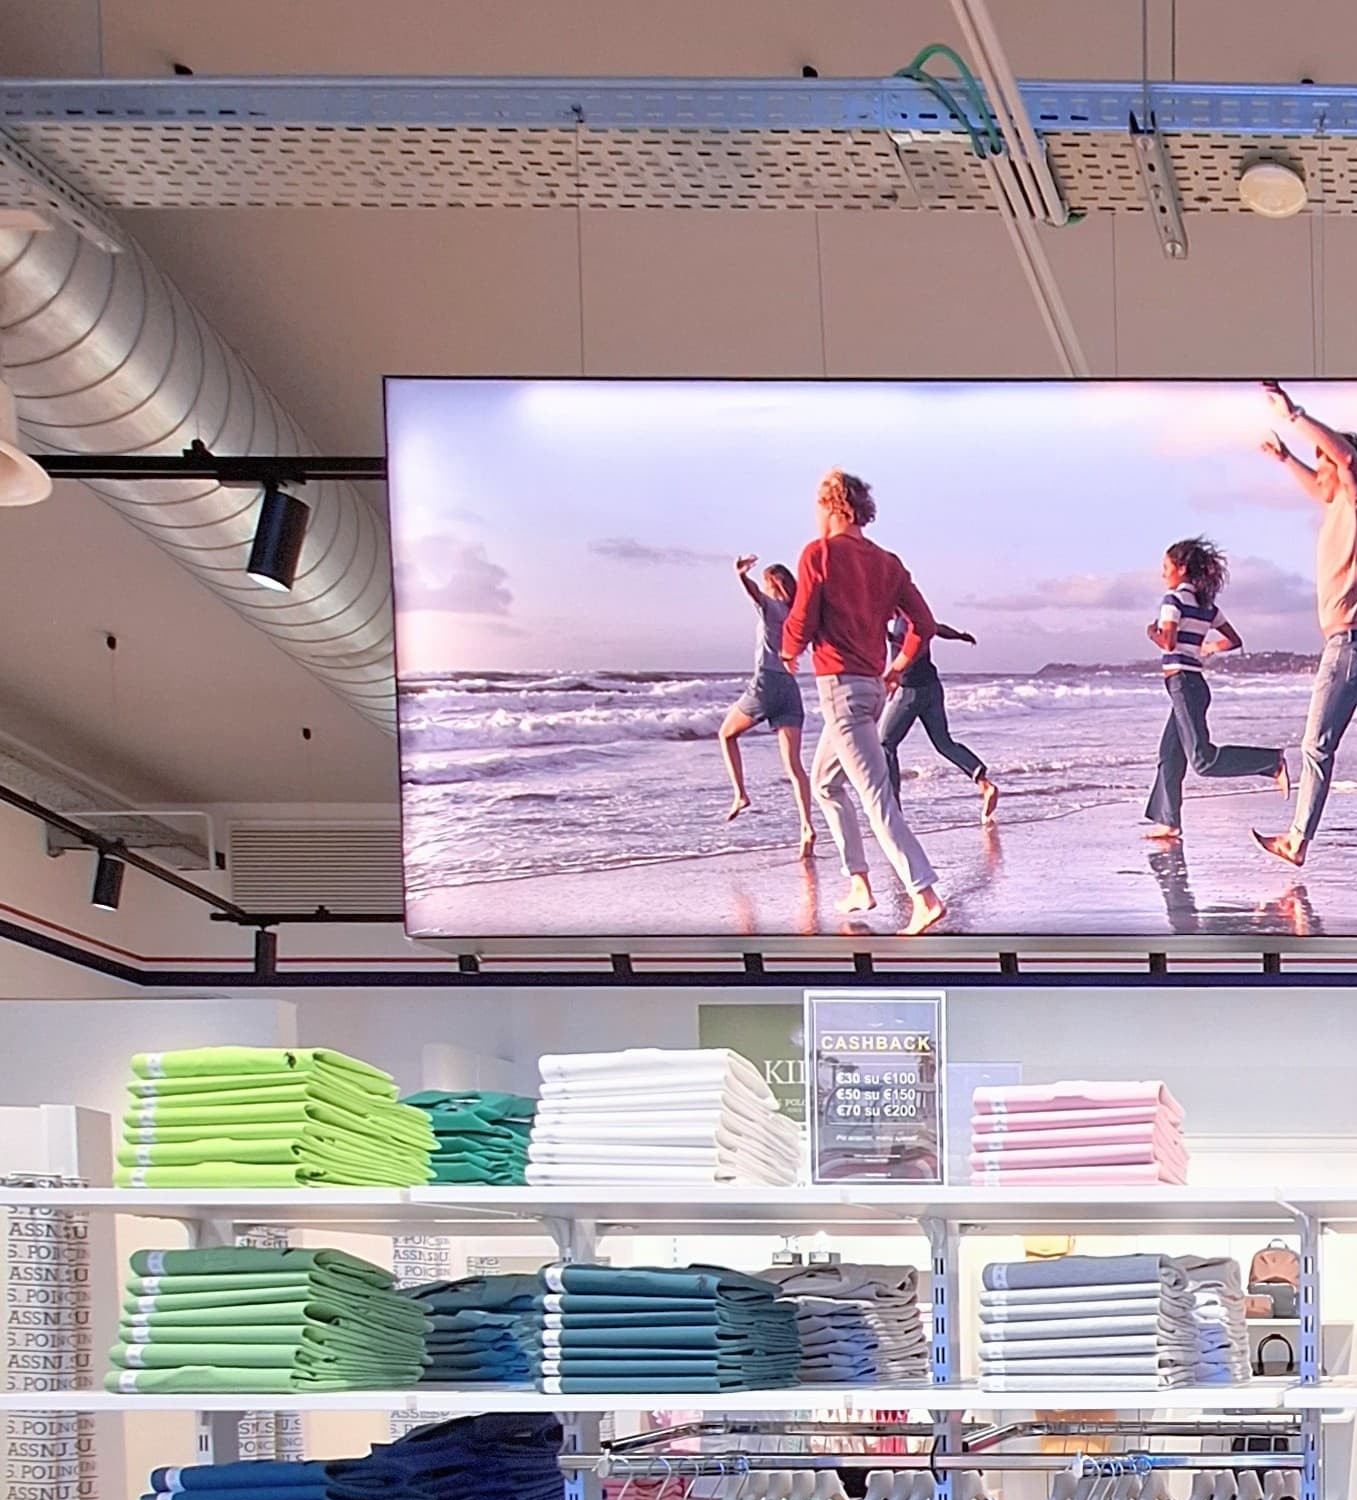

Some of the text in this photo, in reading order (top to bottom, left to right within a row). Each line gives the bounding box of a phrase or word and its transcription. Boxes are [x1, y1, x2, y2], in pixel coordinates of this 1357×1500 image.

[821, 1036, 930, 1050] CASHBACK
[764, 1060, 806, 1084] KI
[836, 1073, 915, 1084] €30 su €100
[836, 1089, 915, 1100] €50 su €150
[836, 1105, 916, 1116] €70 su €200
